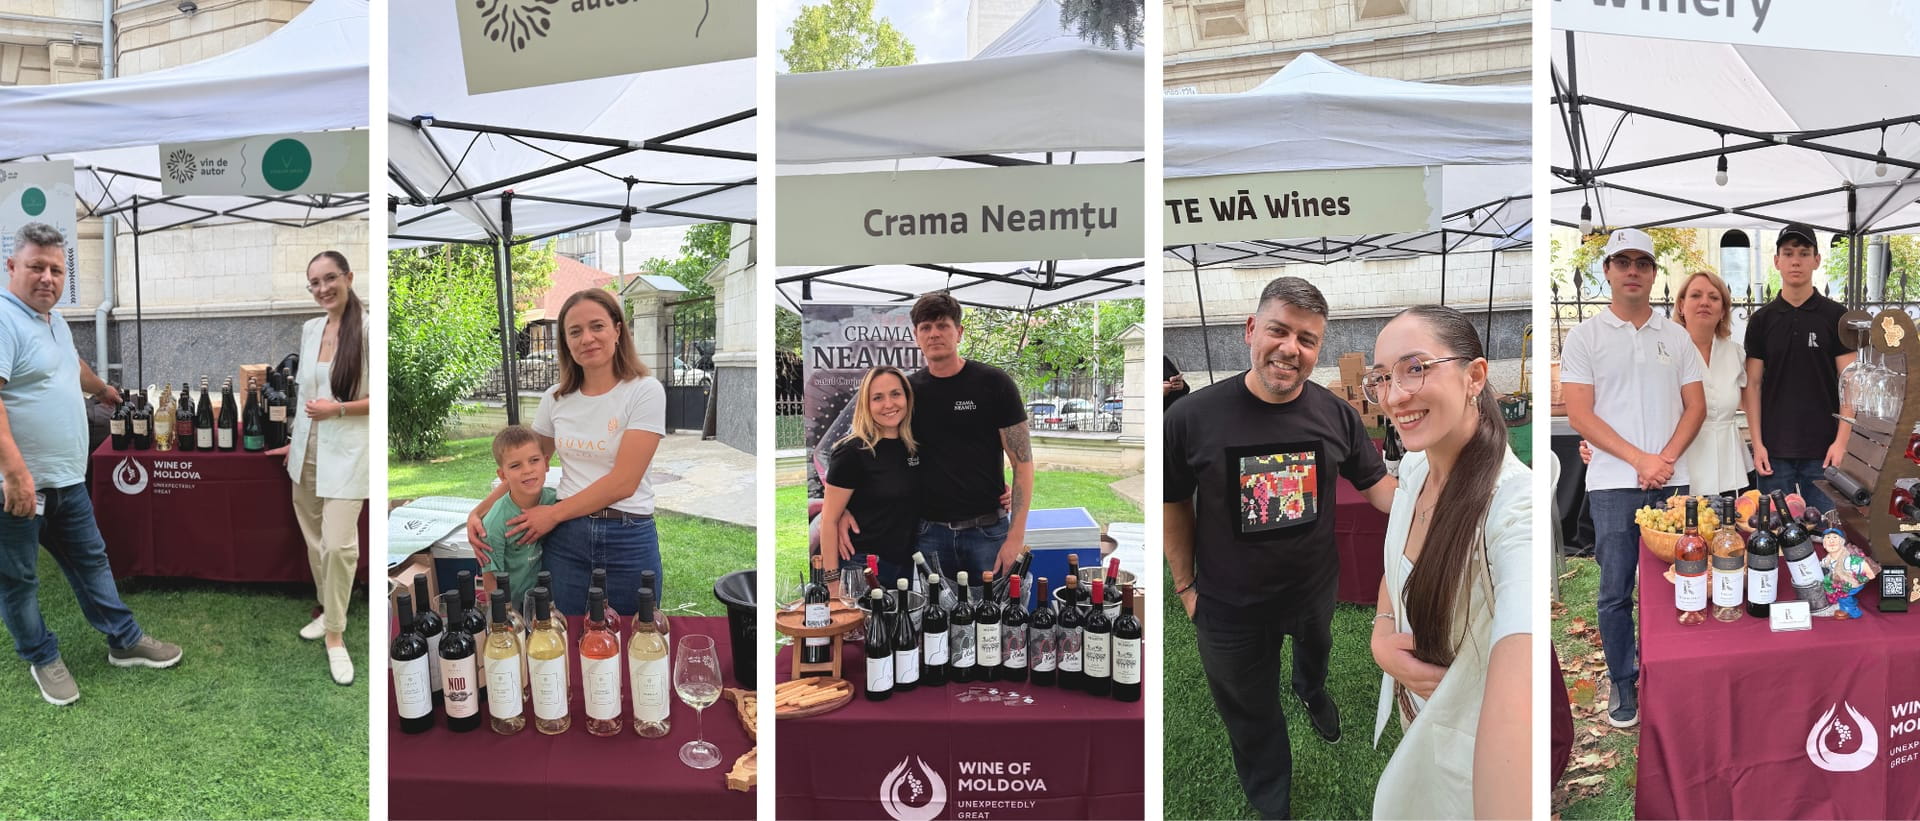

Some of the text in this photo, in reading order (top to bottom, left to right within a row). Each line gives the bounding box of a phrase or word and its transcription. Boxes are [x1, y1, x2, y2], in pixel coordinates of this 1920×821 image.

[200, 158, 228, 167] vin de
[200, 167, 225, 176] autor
[1165, 189, 1351, 224] TE WĀ Wines
[863, 202, 1118, 238] Crama Neamțu
[844, 325, 914, 341] CRAMA
[812, 346, 924, 373] NEAMȚ
[153, 460, 193, 470] WINE OF
[153, 470, 201, 480] MOLDOVA
[447, 677, 466, 690] NOD
[1890, 752, 1919, 769] GREAT
[958, 761, 1031, 775] WINE OF
[958, 778, 1047, 792] MOLDOVA
[957, 800, 1036, 809] UNEXPECTEDLY
[957, 811, 990, 819] GREAT
